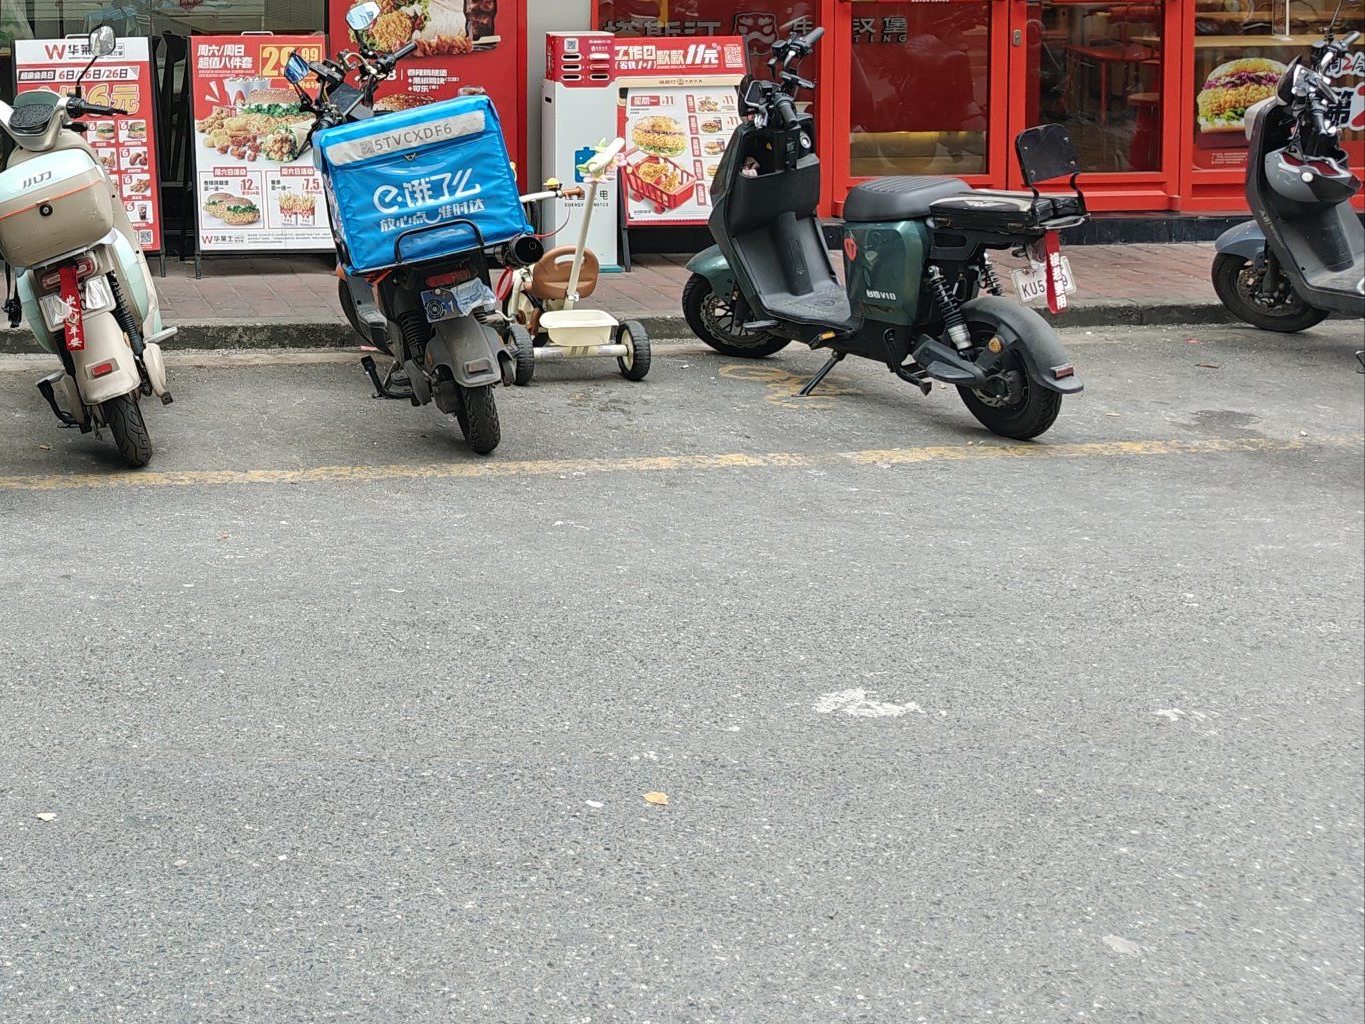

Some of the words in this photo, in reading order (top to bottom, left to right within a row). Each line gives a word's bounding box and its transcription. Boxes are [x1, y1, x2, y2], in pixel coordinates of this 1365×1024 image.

[853, 17, 907, 34] 汉堡
[44, 44, 66, 60] W
[67, 43, 92, 56] 华莱
[197, 44, 246, 57] 周六/周日
[197, 56, 254, 69] 超值八件套
[376, 122, 453, 152] 5TVCXDF6
[403, 167, 482, 209] 饿了么
[380, 211, 427, 233] 放心点
[437, 198, 486, 220] 准时达
